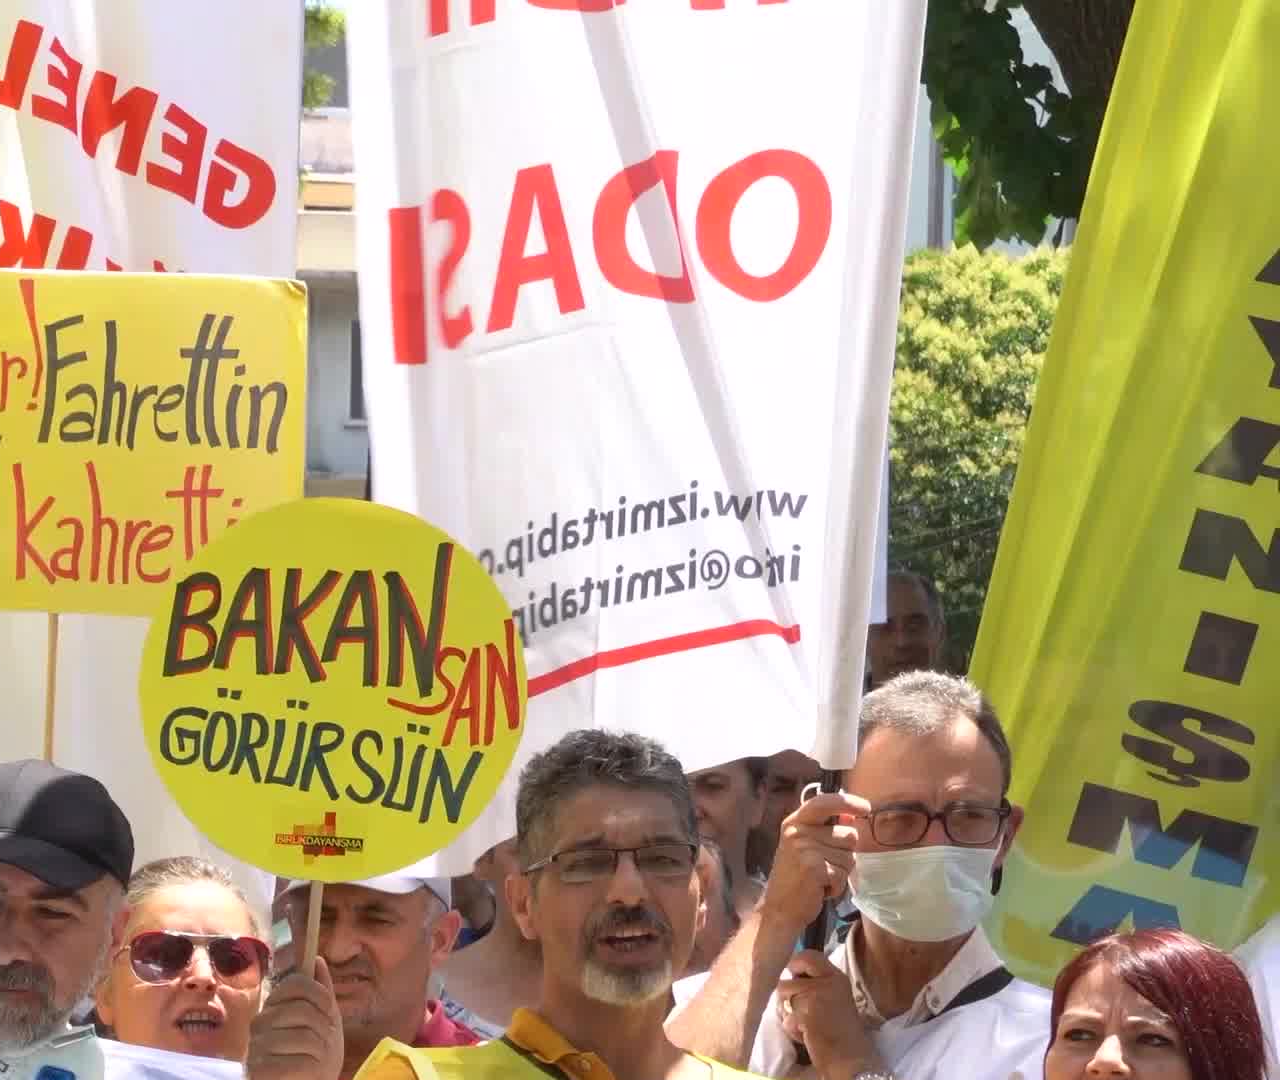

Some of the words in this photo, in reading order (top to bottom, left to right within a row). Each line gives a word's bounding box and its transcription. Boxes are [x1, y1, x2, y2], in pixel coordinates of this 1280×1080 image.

[37, 313, 288, 455] Fahrettin
[12, 461, 243, 584] Kahrett
[160, 687, 483, 824] GÖRÜRSÜN
